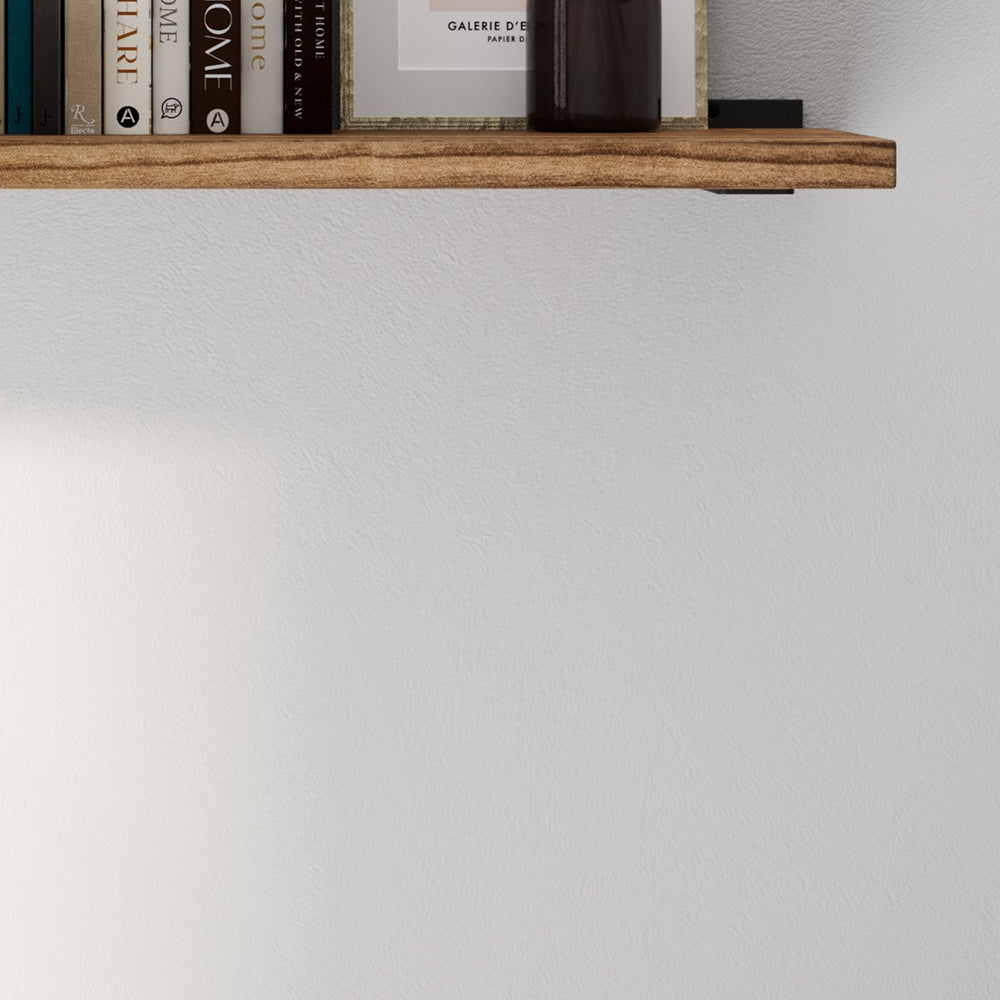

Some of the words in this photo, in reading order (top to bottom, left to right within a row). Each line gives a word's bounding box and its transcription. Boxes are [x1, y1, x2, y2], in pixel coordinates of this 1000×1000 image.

[448, 21, 499, 31] GALERIE
[316, 17, 324, 58] HOME
[294, 72, 303, 82] &
